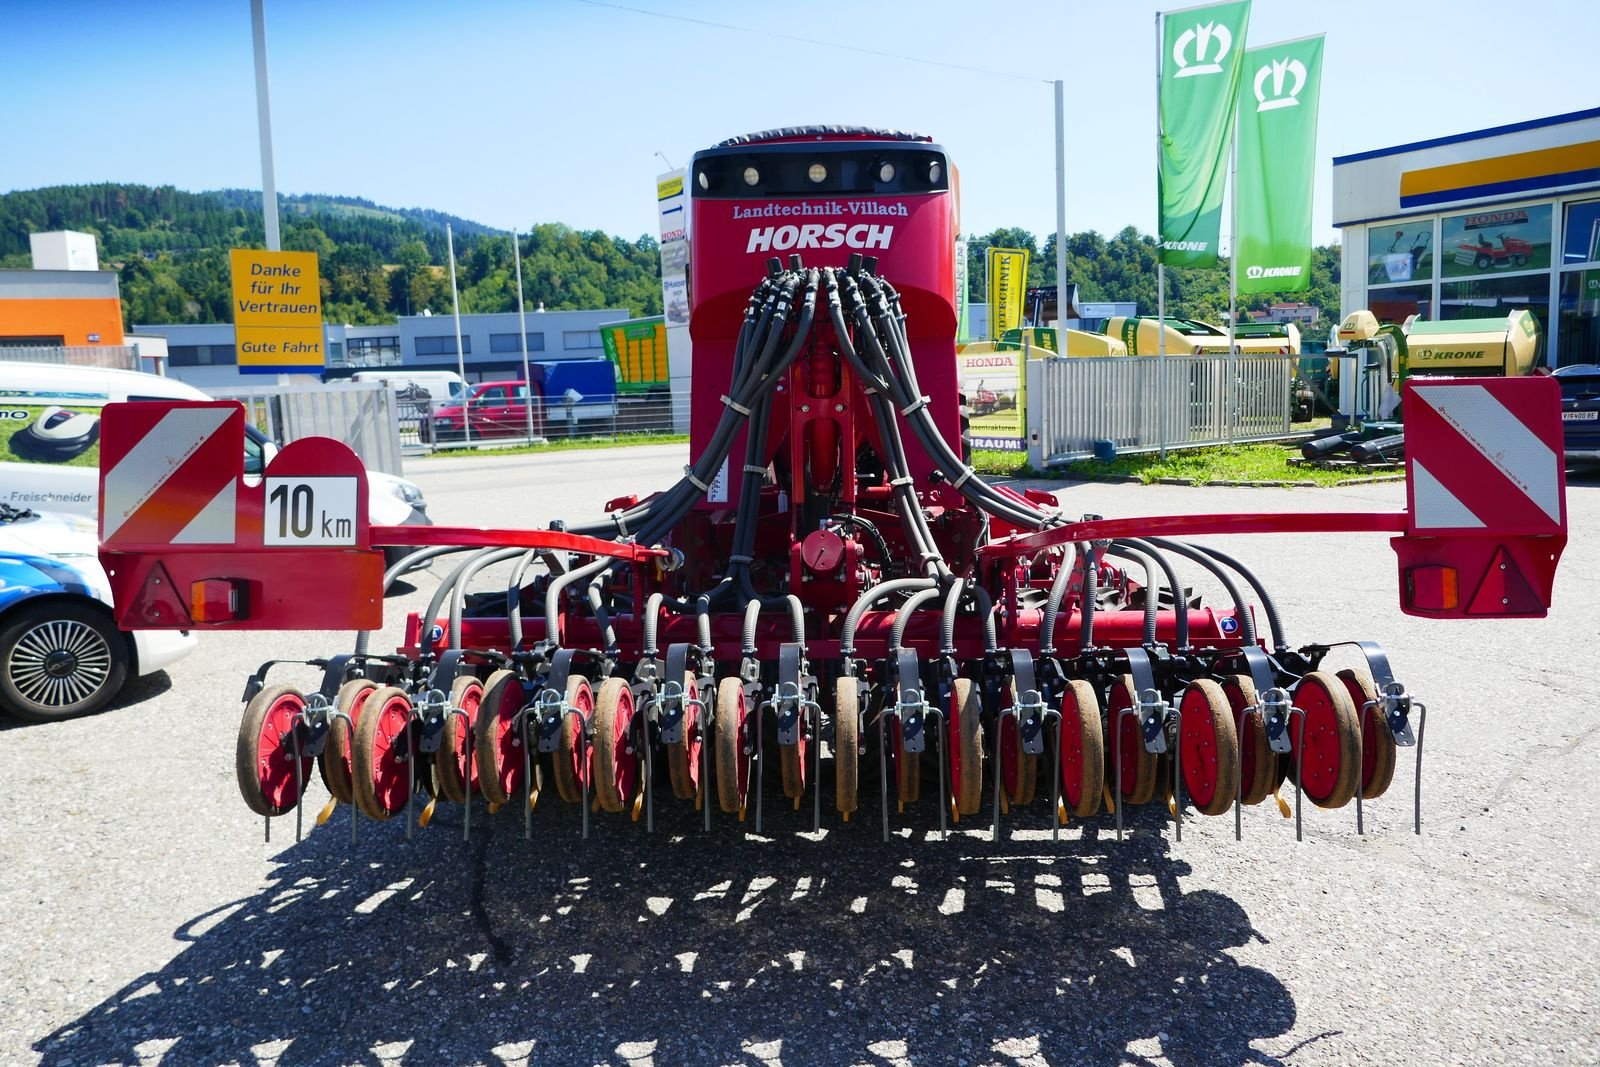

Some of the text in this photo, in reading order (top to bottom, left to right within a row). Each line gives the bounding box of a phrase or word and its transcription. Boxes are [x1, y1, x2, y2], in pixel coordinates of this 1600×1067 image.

[733, 202, 908, 219] Landtechnik-Villach
[1464, 209, 1529, 225] HONDA
[746, 223, 894, 253] HORSCH
[251, 263, 301, 277] Danke
[1263, 266, 1302, 278] KRONE
[251, 281, 301, 295] für Ihr
[239, 300, 317, 314] Vertrauen
[242, 341, 319, 353] Gute Fahrt
[966, 357, 1013, 367] HONDA
[1434, 350, 1485, 360] KRONE
[10, 491, 93, 503] Freischneider
[270, 484, 352, 538] 10 km
